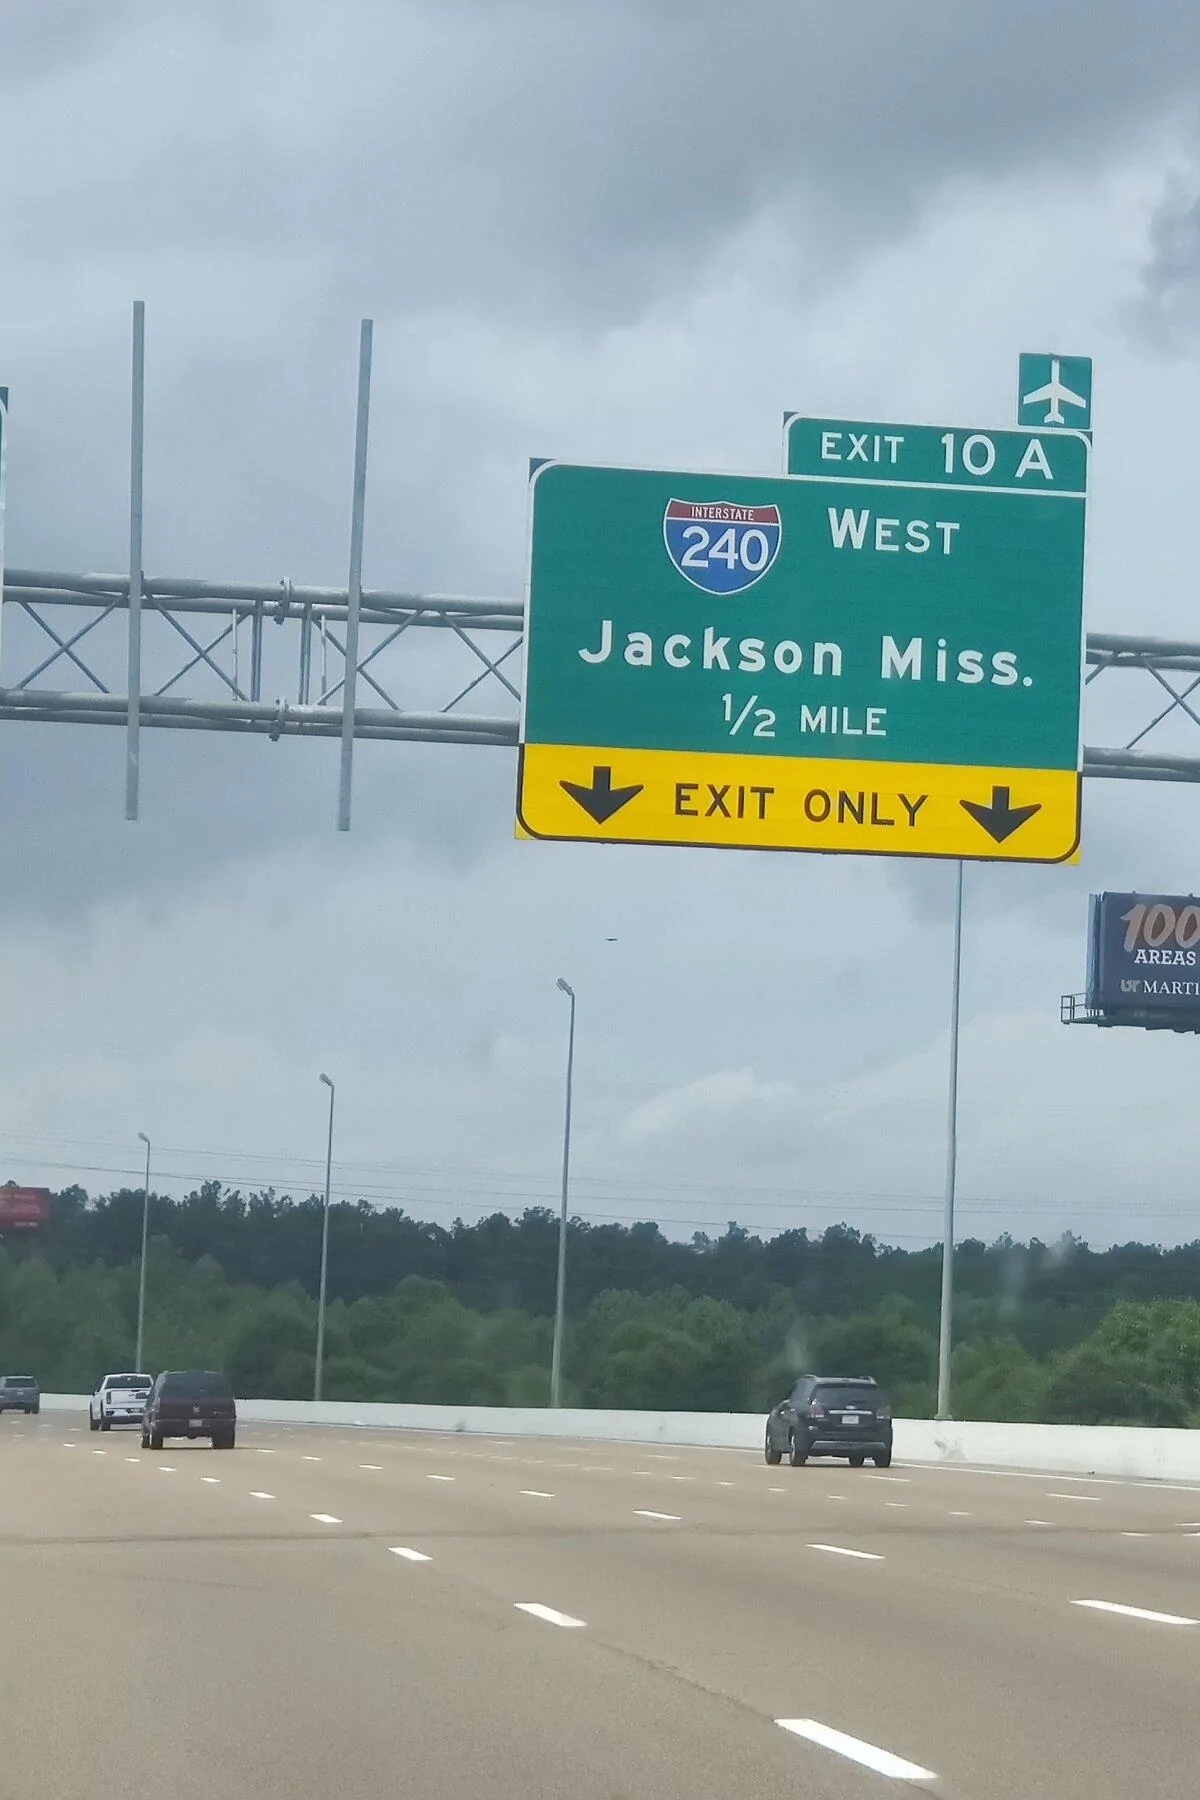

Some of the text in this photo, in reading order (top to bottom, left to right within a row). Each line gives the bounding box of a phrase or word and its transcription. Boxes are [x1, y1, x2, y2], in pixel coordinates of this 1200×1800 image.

[821, 432, 1054, 480] EXIT 10 A
[690, 506, 754, 521] INTERSTATE
[828, 508, 959, 554] WEST
[680, 527, 769, 571] 240
[578, 620, 1033, 687] Jackson Miss.
[800, 705, 887, 736] MILE
[674, 783, 928, 827] EXIT ONLY
[1133, 949, 1195, 966] AREAS
